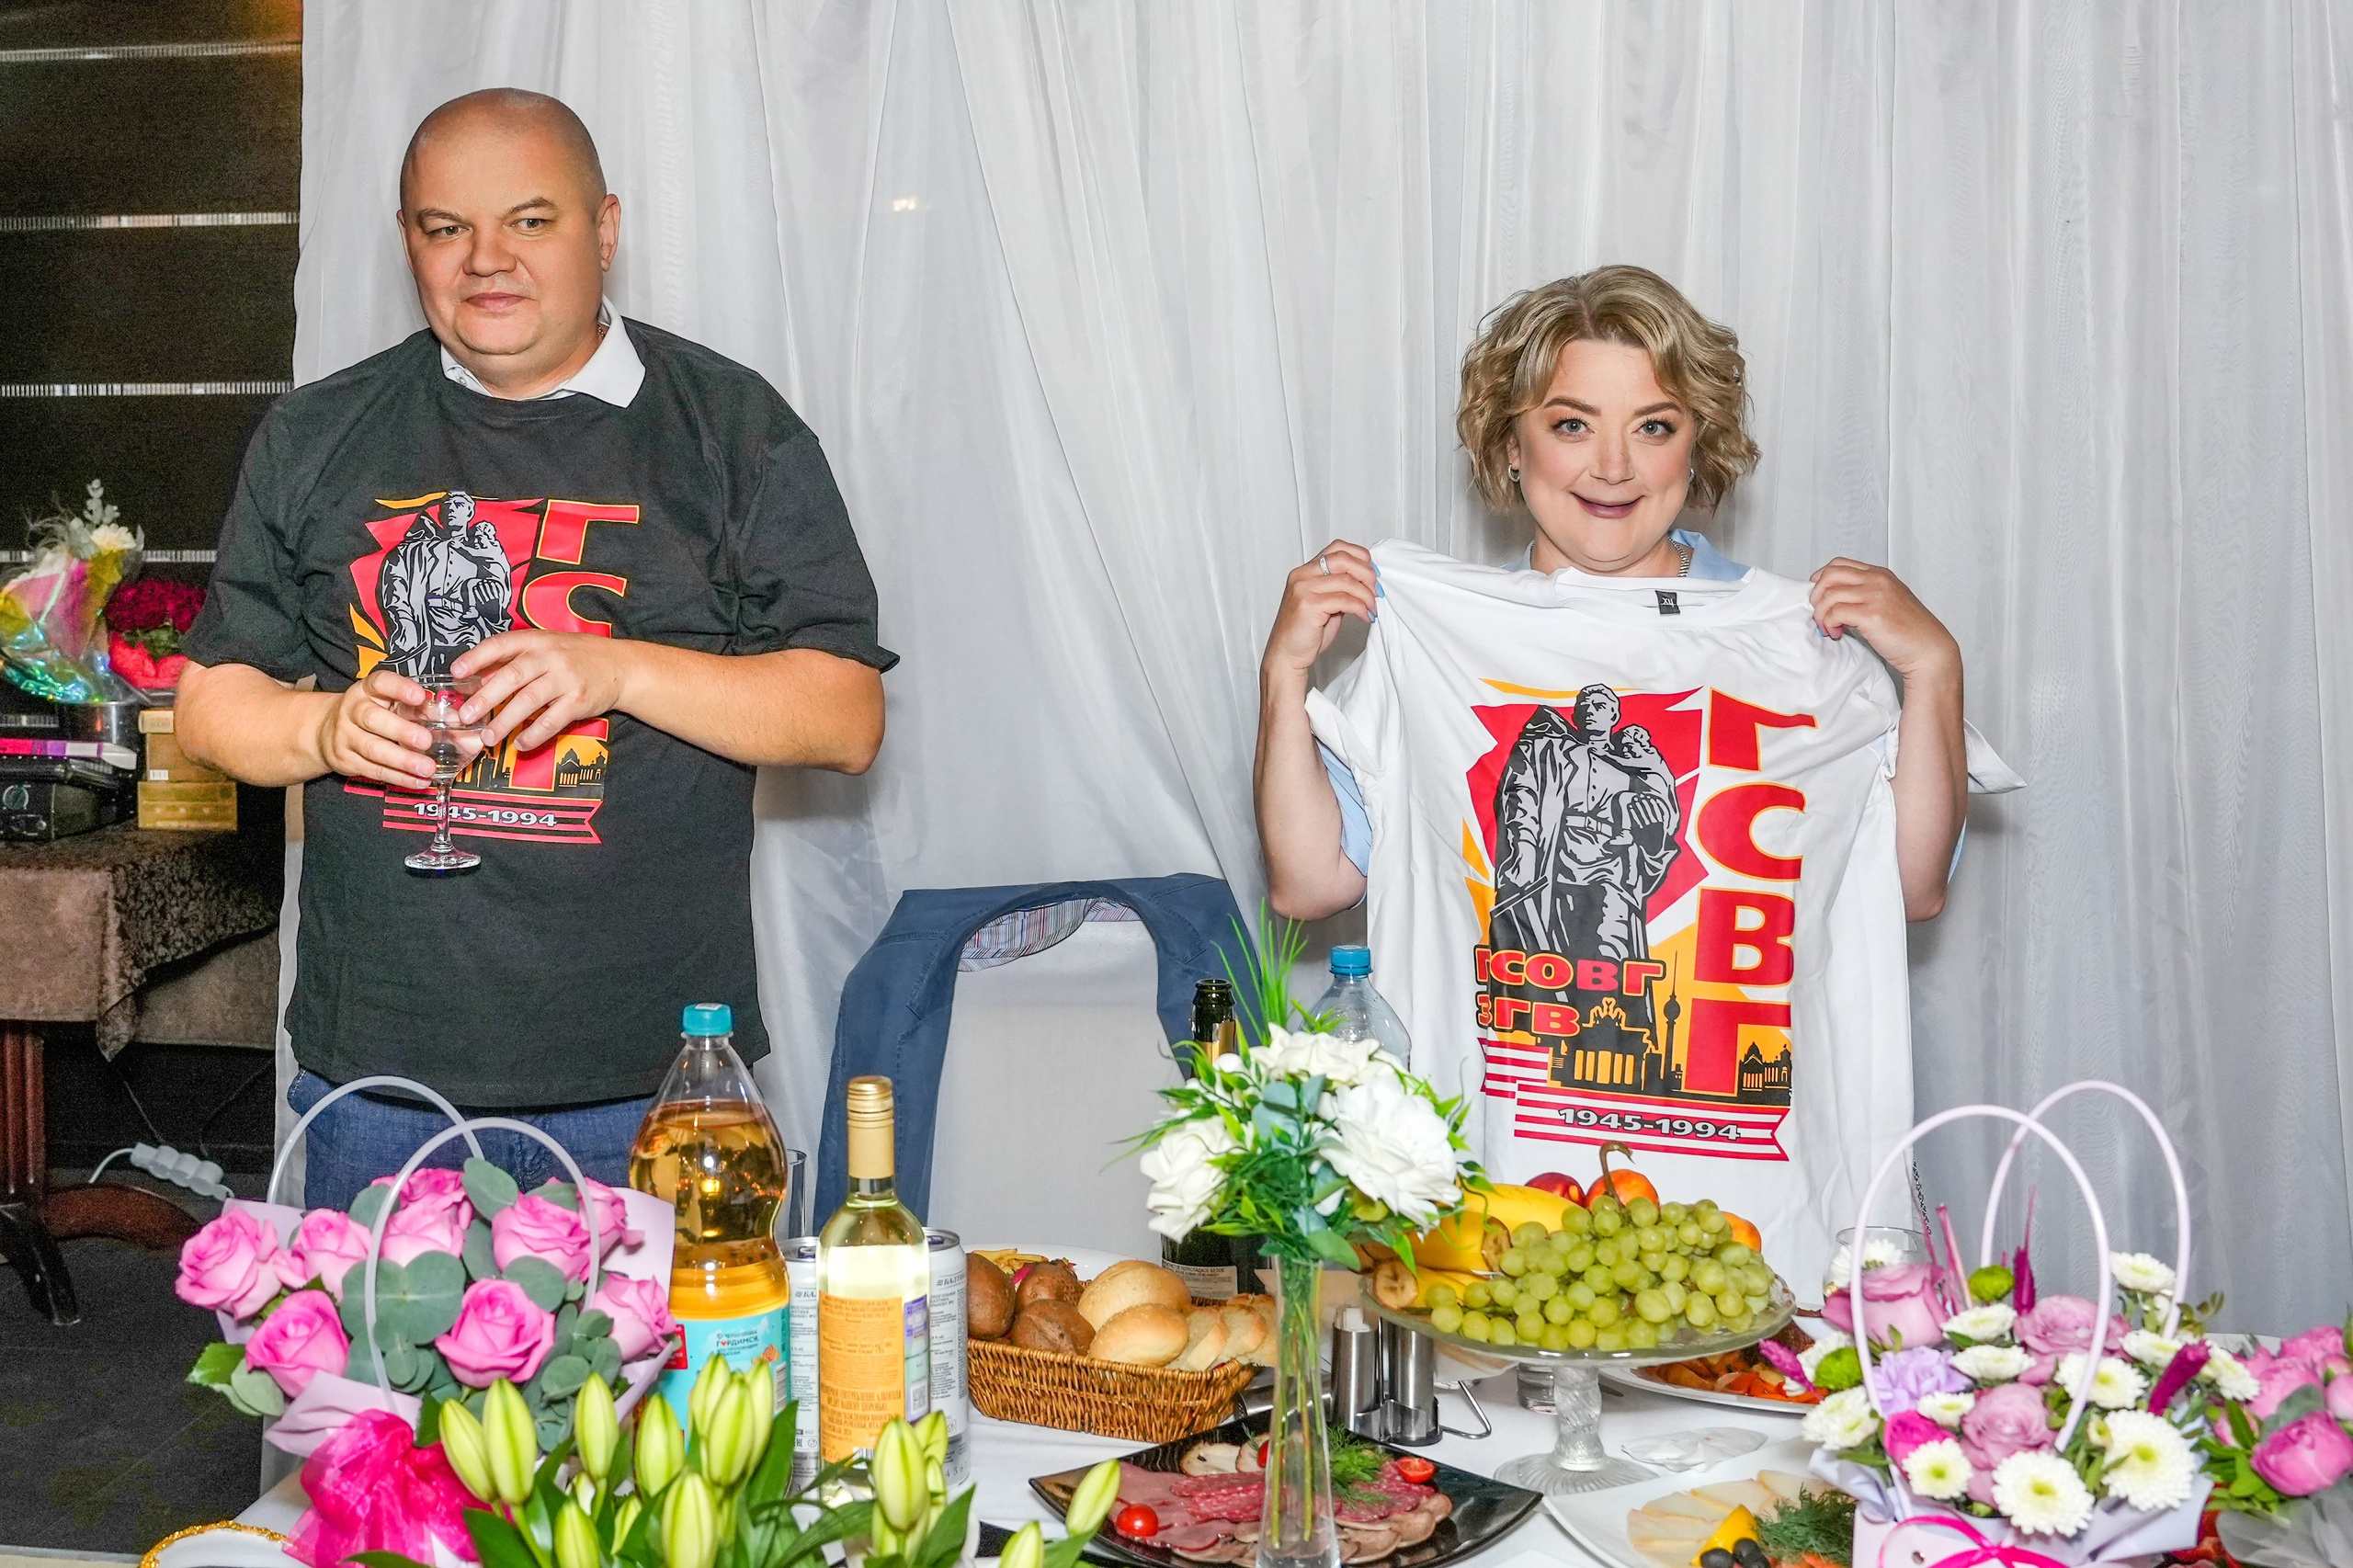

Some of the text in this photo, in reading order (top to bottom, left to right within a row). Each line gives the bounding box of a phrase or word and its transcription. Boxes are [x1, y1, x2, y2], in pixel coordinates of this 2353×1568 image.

[413, 801, 557, 828] 1945-1994
[1684, 686, 1819, 1097] ГСВГ
[1474, 947, 1665, 997] ГСОВГ
[1476, 994, 1581, 1038] ЗГВ
[1557, 1108, 1742, 1142] 1945-1994
